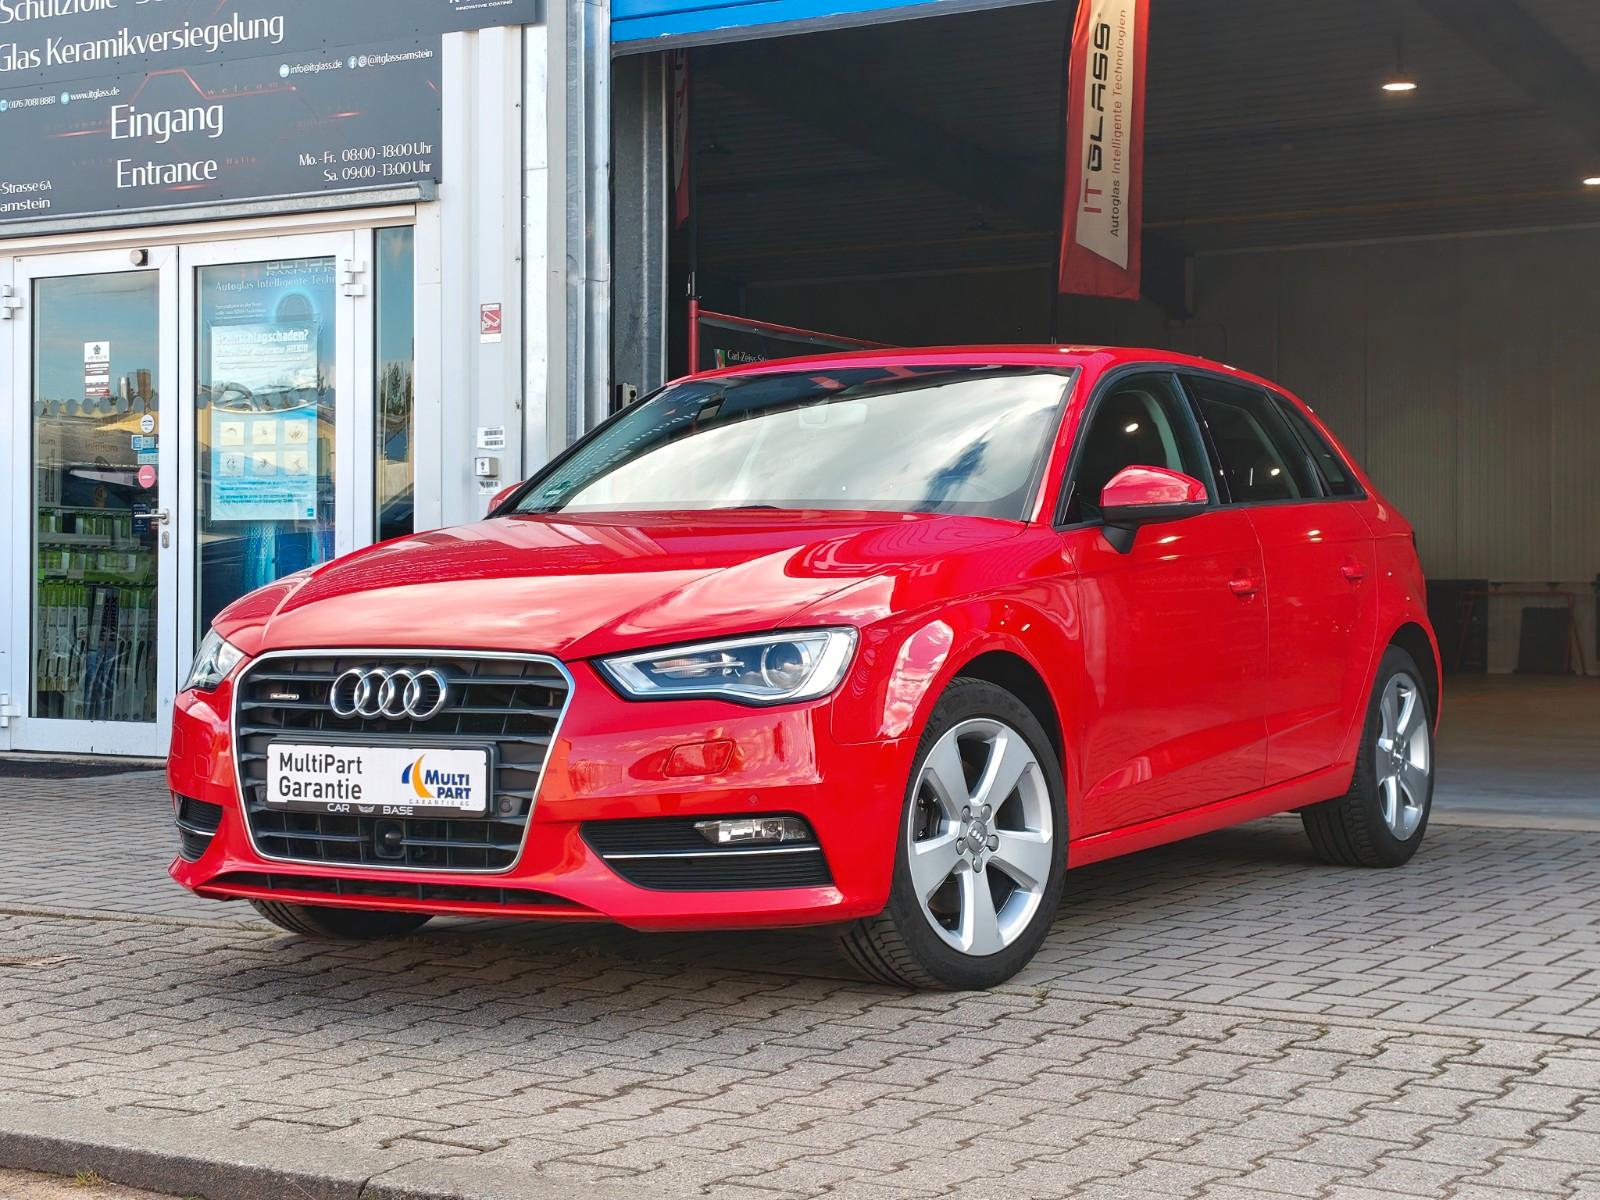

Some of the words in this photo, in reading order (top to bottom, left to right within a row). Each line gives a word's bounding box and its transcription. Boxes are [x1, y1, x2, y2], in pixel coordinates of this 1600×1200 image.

[46, 12, 285, 67] Keramikversiegelung
[1112, 9, 1127, 97] Technologien
[70, 86, 120, 101] www.itglass.de
[1088, 23, 1110, 172] GLASS
[111, 104, 225, 144] Eingang
[413, 141, 433, 155] Uhr
[1111, 100, 1124, 174] Intelligente
[116, 158, 218, 189] Entrance
[323, 168, 339, 181] Sa.
[412, 159, 432, 174] Uhr
[39, 180, 52, 191] 6A
[1084, 178, 1103, 213] IT
[1110, 180, 1121, 237] Autoglas
[280, 752, 362, 774] MultiPart
[279, 775, 362, 800] Garantie
[437, 786, 471, 800] PART
[327, 803, 350, 813] CAR
[382, 805, 414, 816] BASE
